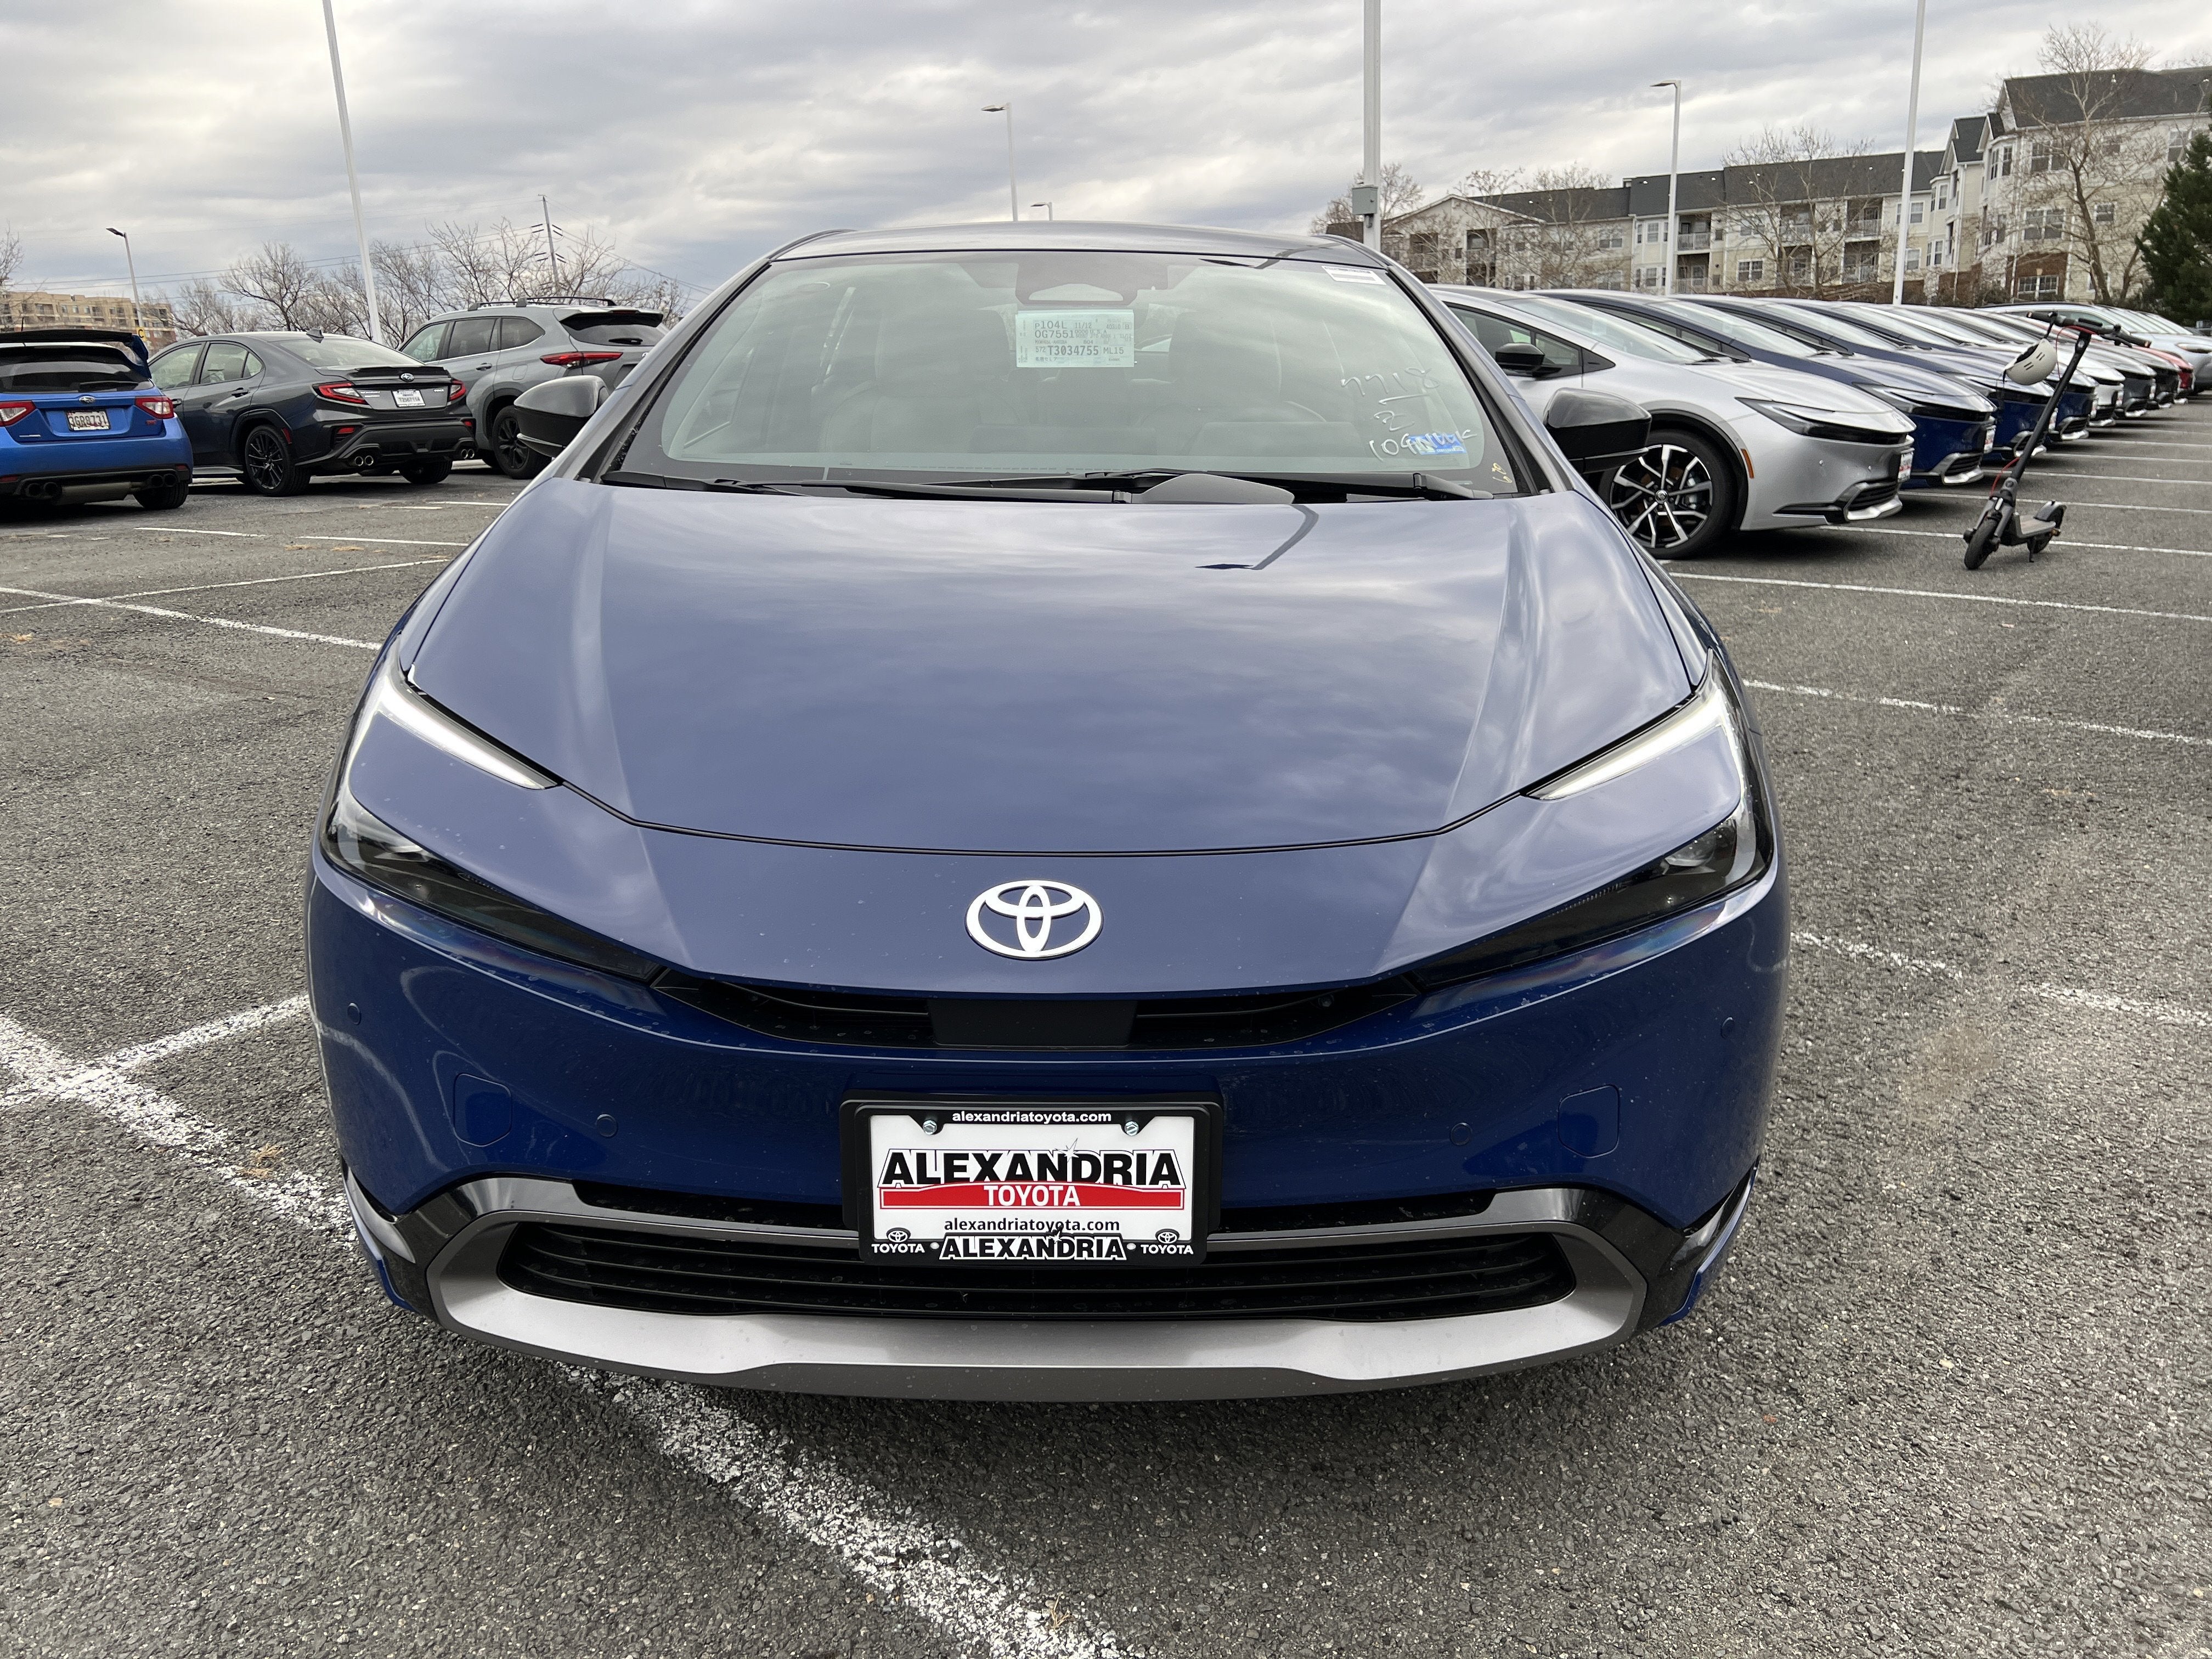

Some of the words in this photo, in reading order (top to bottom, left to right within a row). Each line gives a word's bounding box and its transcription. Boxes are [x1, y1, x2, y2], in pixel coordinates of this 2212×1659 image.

[138, 329, 144, 338] C
[1047, 345, 1099, 356] T3034755
[952, 1111, 1111, 1124] alexandriatoyota.com
[880, 1149, 1184, 1188] ALEXANDRIA
[984, 1185, 1081, 1206] TOYOTA
[944, 1218, 1120, 1232] alexandriatoyota.com
[871, 1243, 925, 1255] TOYOTA
[939, 1234, 1127, 1261] ALEXANDRIA
[1141, 1244, 1194, 1256] TOYOTA
